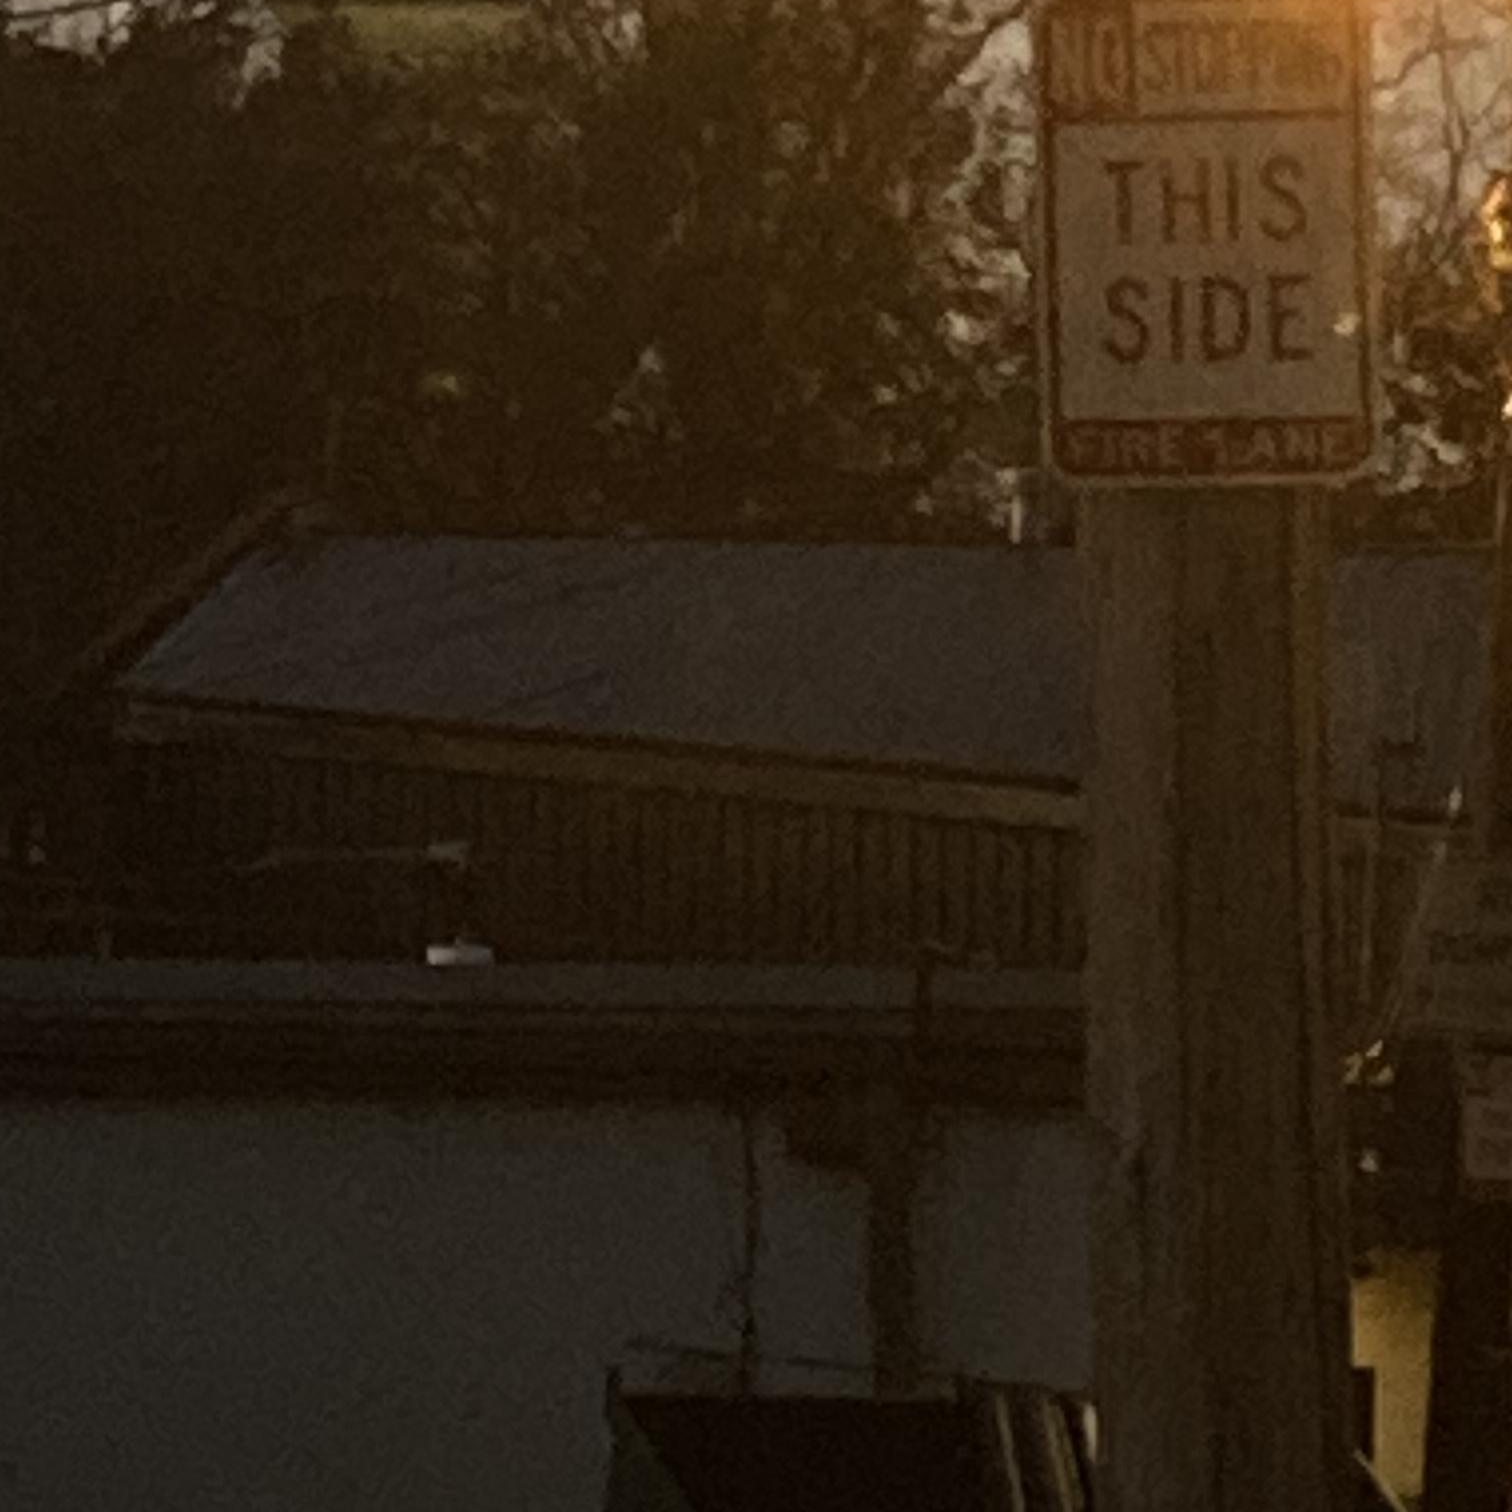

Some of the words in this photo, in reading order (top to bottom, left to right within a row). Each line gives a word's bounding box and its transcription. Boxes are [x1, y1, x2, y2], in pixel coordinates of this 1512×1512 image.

[1050, 19, 1126, 102] NO
[1143, 20, 1343, 92] STOPP
[1103, 154, 1308, 245] THIS
[1103, 272, 1314, 365] SIDE
[1064, 424, 1181, 467] FIRE
